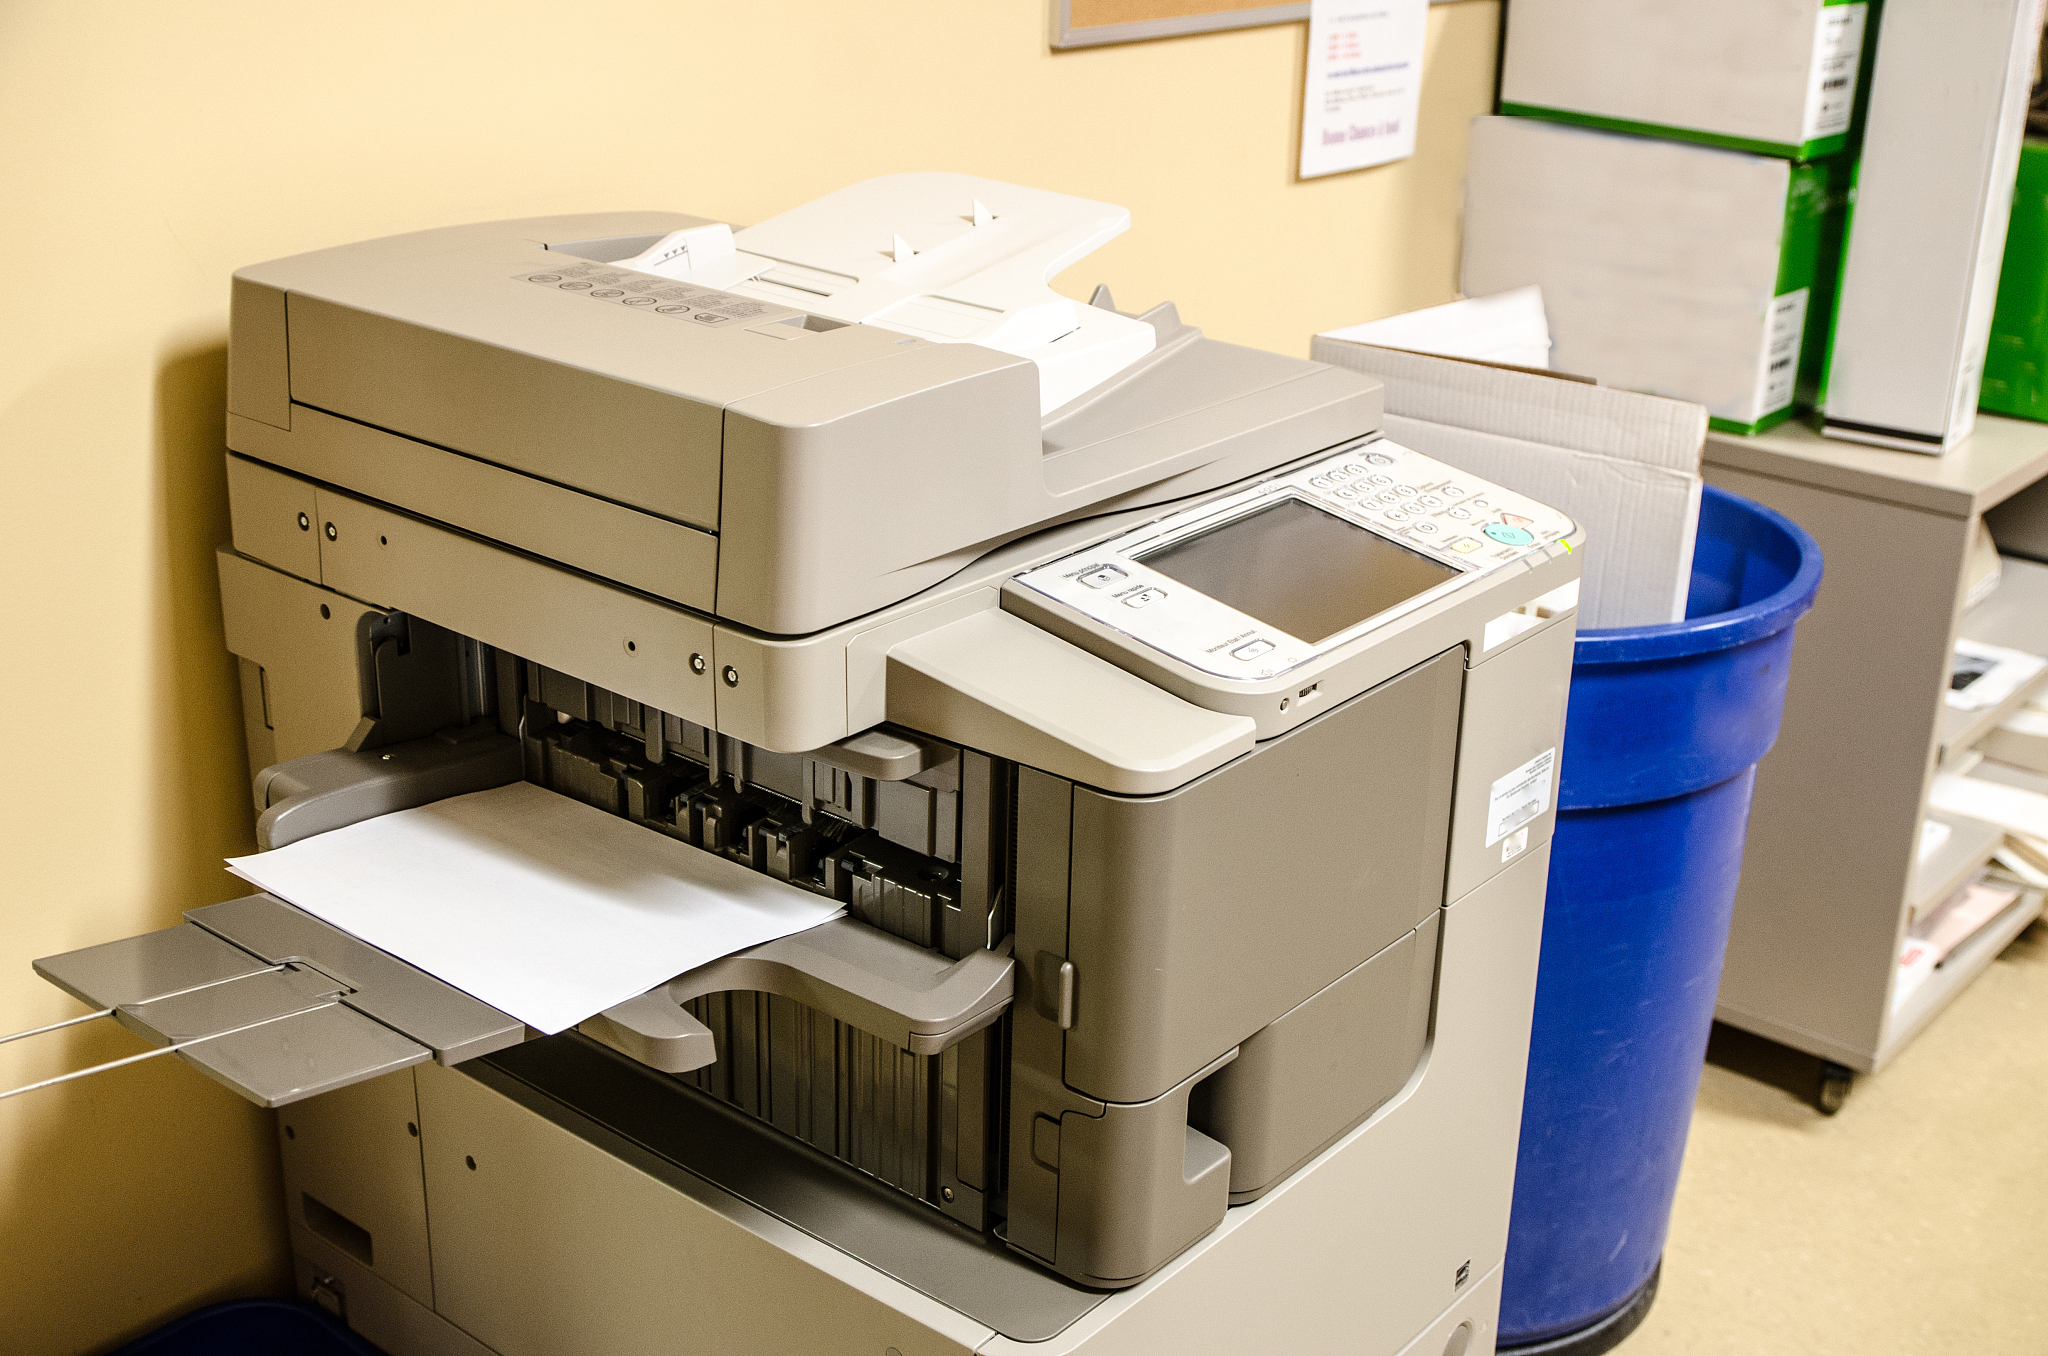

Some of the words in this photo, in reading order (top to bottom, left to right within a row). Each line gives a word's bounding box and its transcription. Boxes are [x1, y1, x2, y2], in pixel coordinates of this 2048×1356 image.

[1063, 570, 1079, 579] Menu
[1078, 562, 1101, 575] principal
[1111, 590, 1128, 599] Menu
[1127, 583, 1145, 594] rapide
